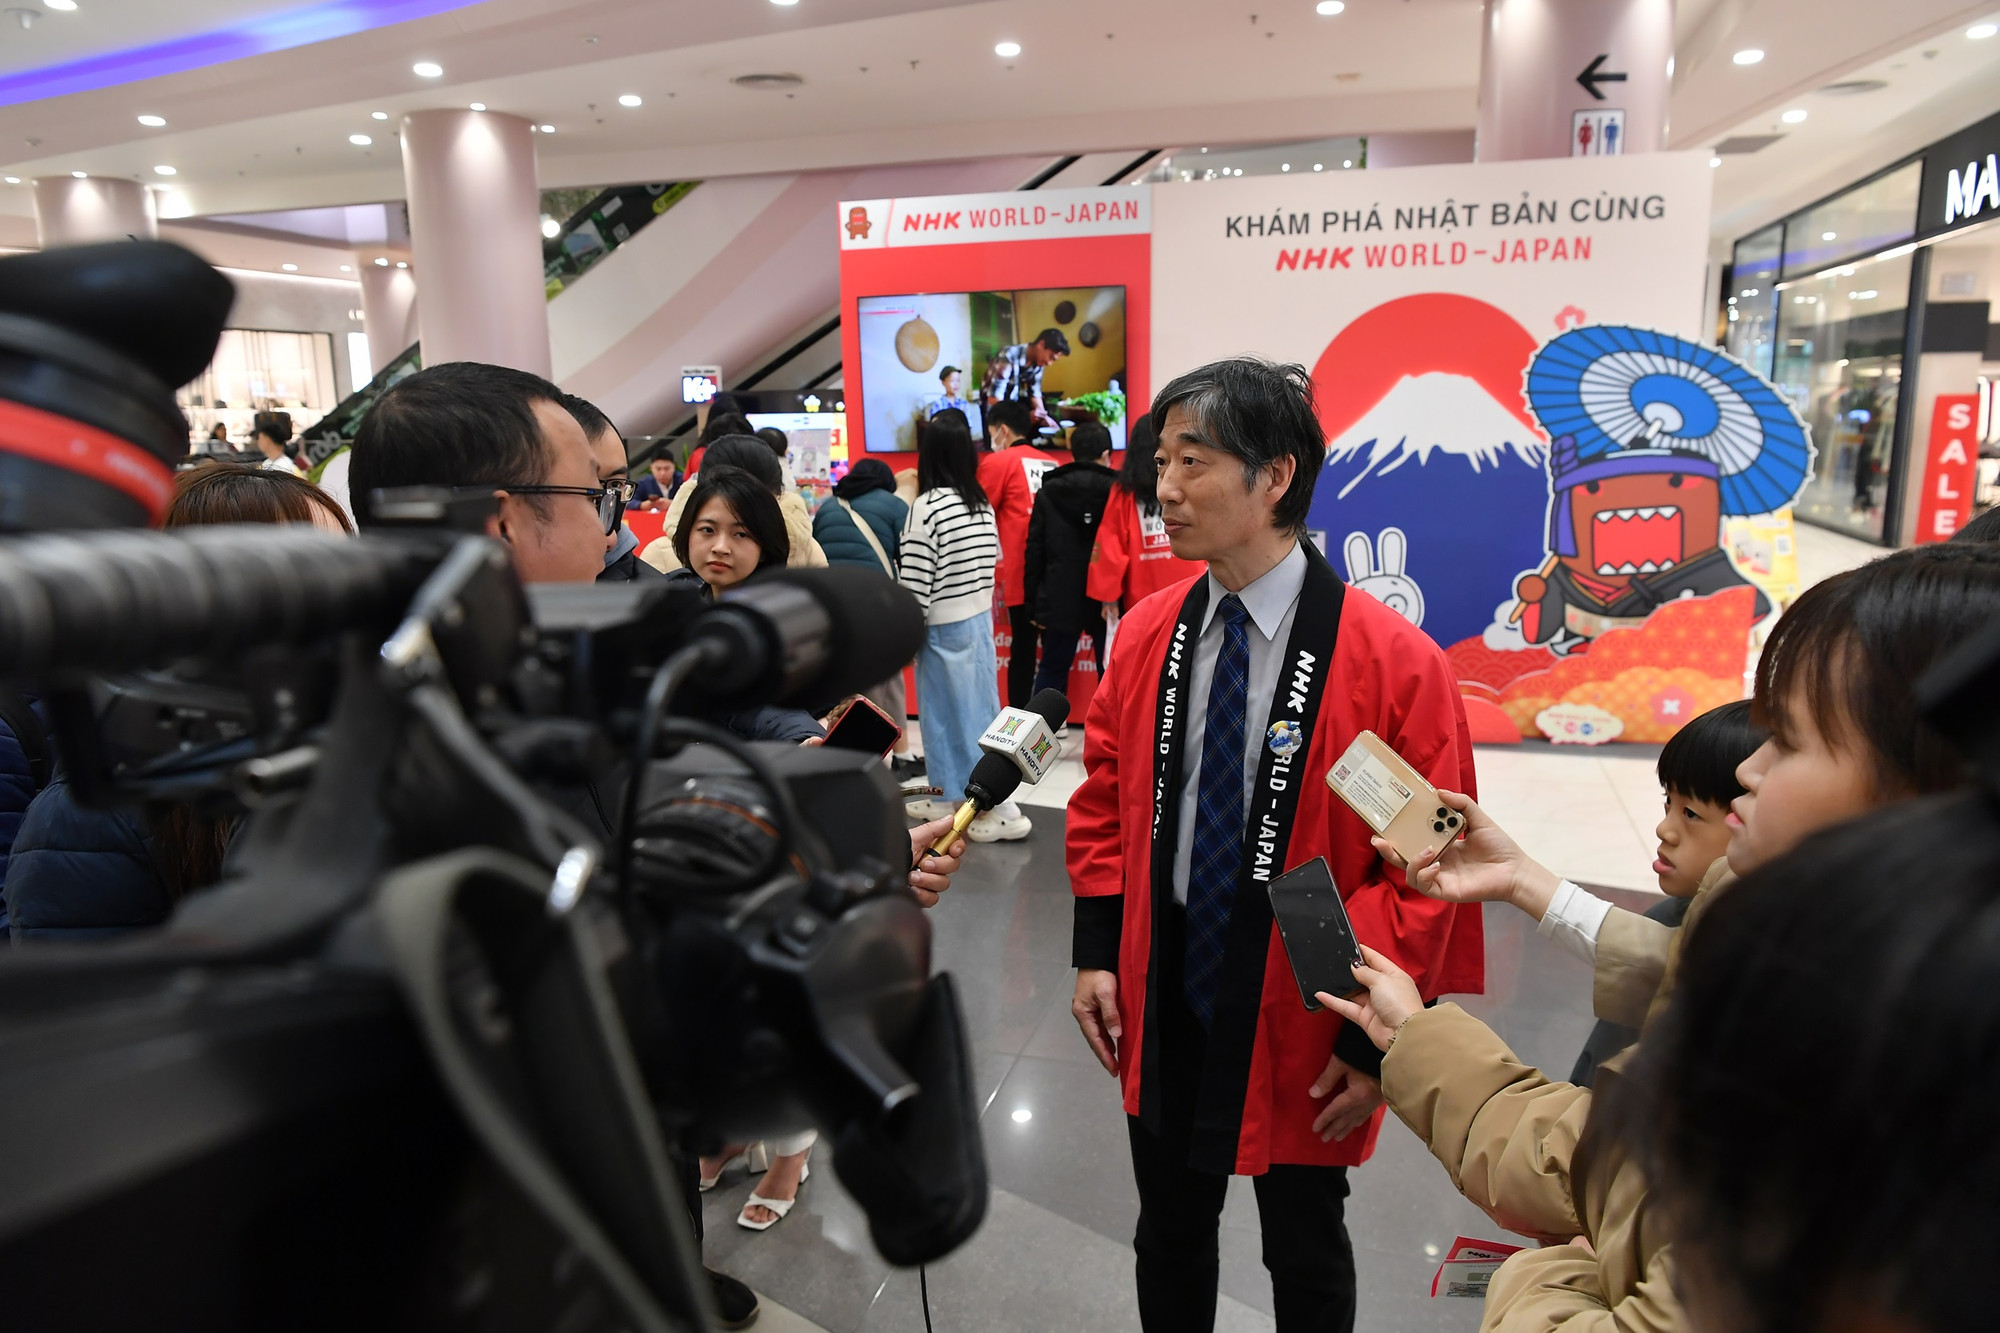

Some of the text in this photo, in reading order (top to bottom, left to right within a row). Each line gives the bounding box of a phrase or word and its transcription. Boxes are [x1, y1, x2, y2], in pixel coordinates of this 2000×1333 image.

[903, 211, 961, 232] NHK
[1225, 190, 1666, 238] KHÁM PHÁ NHẬT BẢN CÙNG
[1275, 247, 1354, 271] NHK
[1932, 403, 1971, 535] SALE
[1167, 622, 1188, 680] NHK
[1287, 650, 1316, 713] NHK
[1159, 687, 1177, 755] WORLD
[1253, 814, 1279, 882] JAPAN
